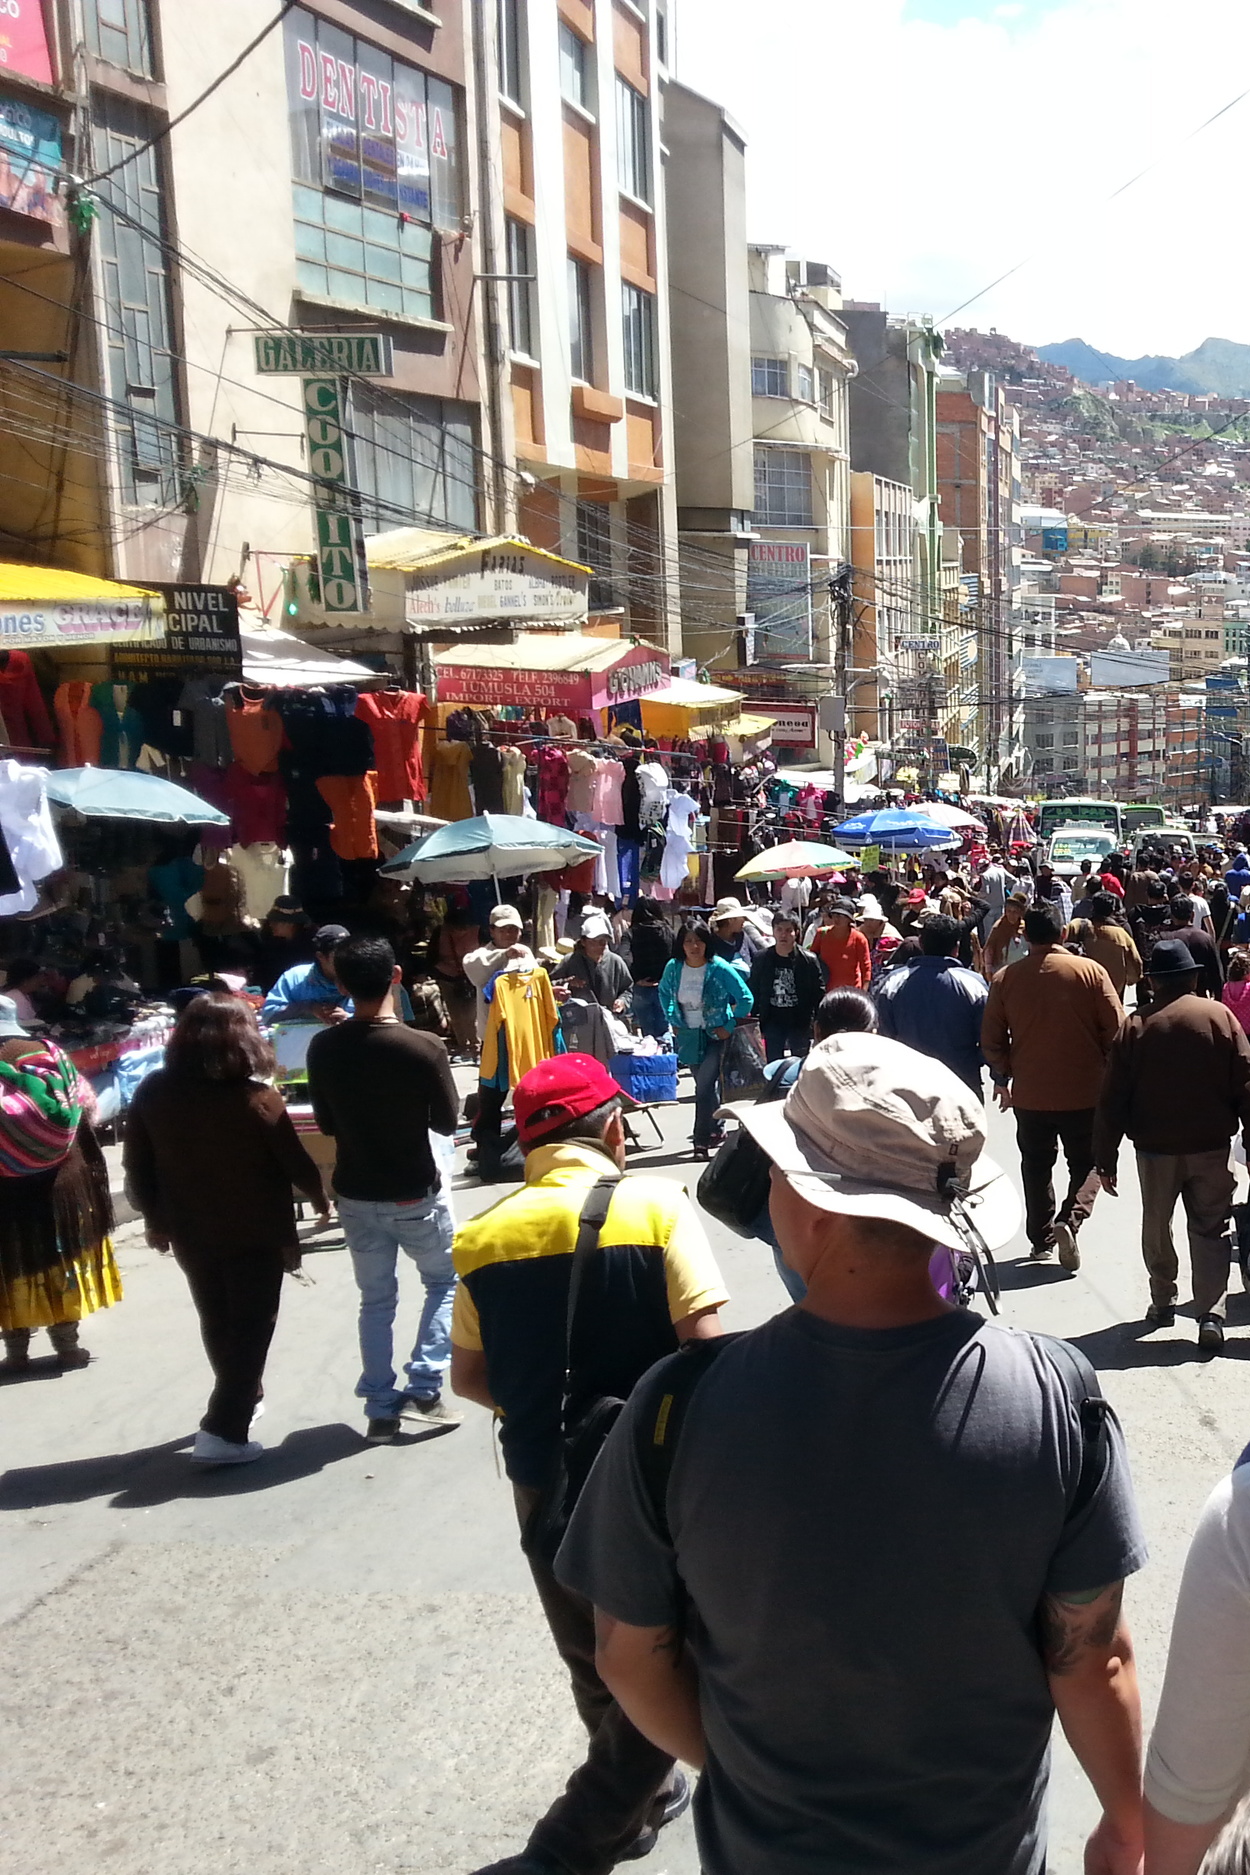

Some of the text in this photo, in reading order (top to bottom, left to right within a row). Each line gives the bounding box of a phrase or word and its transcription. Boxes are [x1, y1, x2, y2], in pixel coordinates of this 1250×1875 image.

[298, 40, 447, 159] DENTISTA
[258, 337, 378, 371] GALERIA
[751, 544, 806, 563] CENTRO
[173, 591, 229, 612] NIVEL
[171, 636, 185, 650] DE
[901, 640, 940, 649] CENTRO
[460, 668, 504, 680] 67173325
[460, 680, 556, 697] TUMUSLA 504
[445, 692, 503, 704] IMPORT
[515, 695, 571, 707] EXPORT
